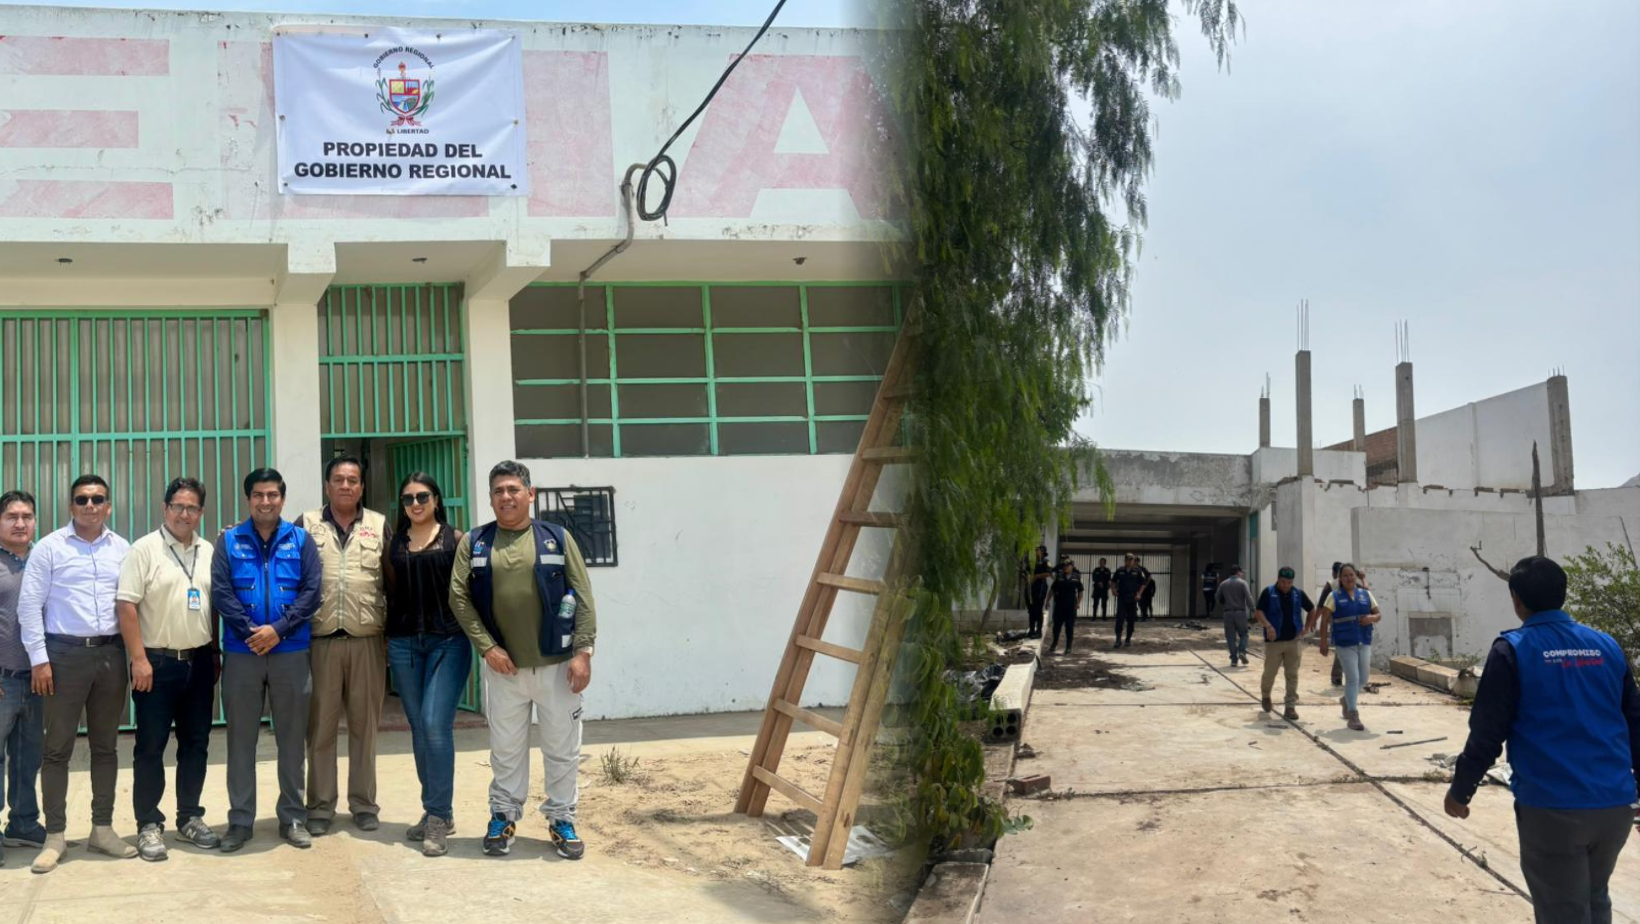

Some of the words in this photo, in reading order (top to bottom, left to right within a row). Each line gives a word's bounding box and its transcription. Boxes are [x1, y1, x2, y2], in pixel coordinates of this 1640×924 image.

[373, 46, 404, 69] GOBIERNO
[405, 46, 435, 70] REGIONAL
[323, 141, 438, 158] PROPIEDAD
[444, 143, 483, 158] DEL
[294, 162, 403, 179] GOBIERNO
[409, 163, 512, 179] REGIONAL
[1543, 649, 1601, 658] COMPROMISO
